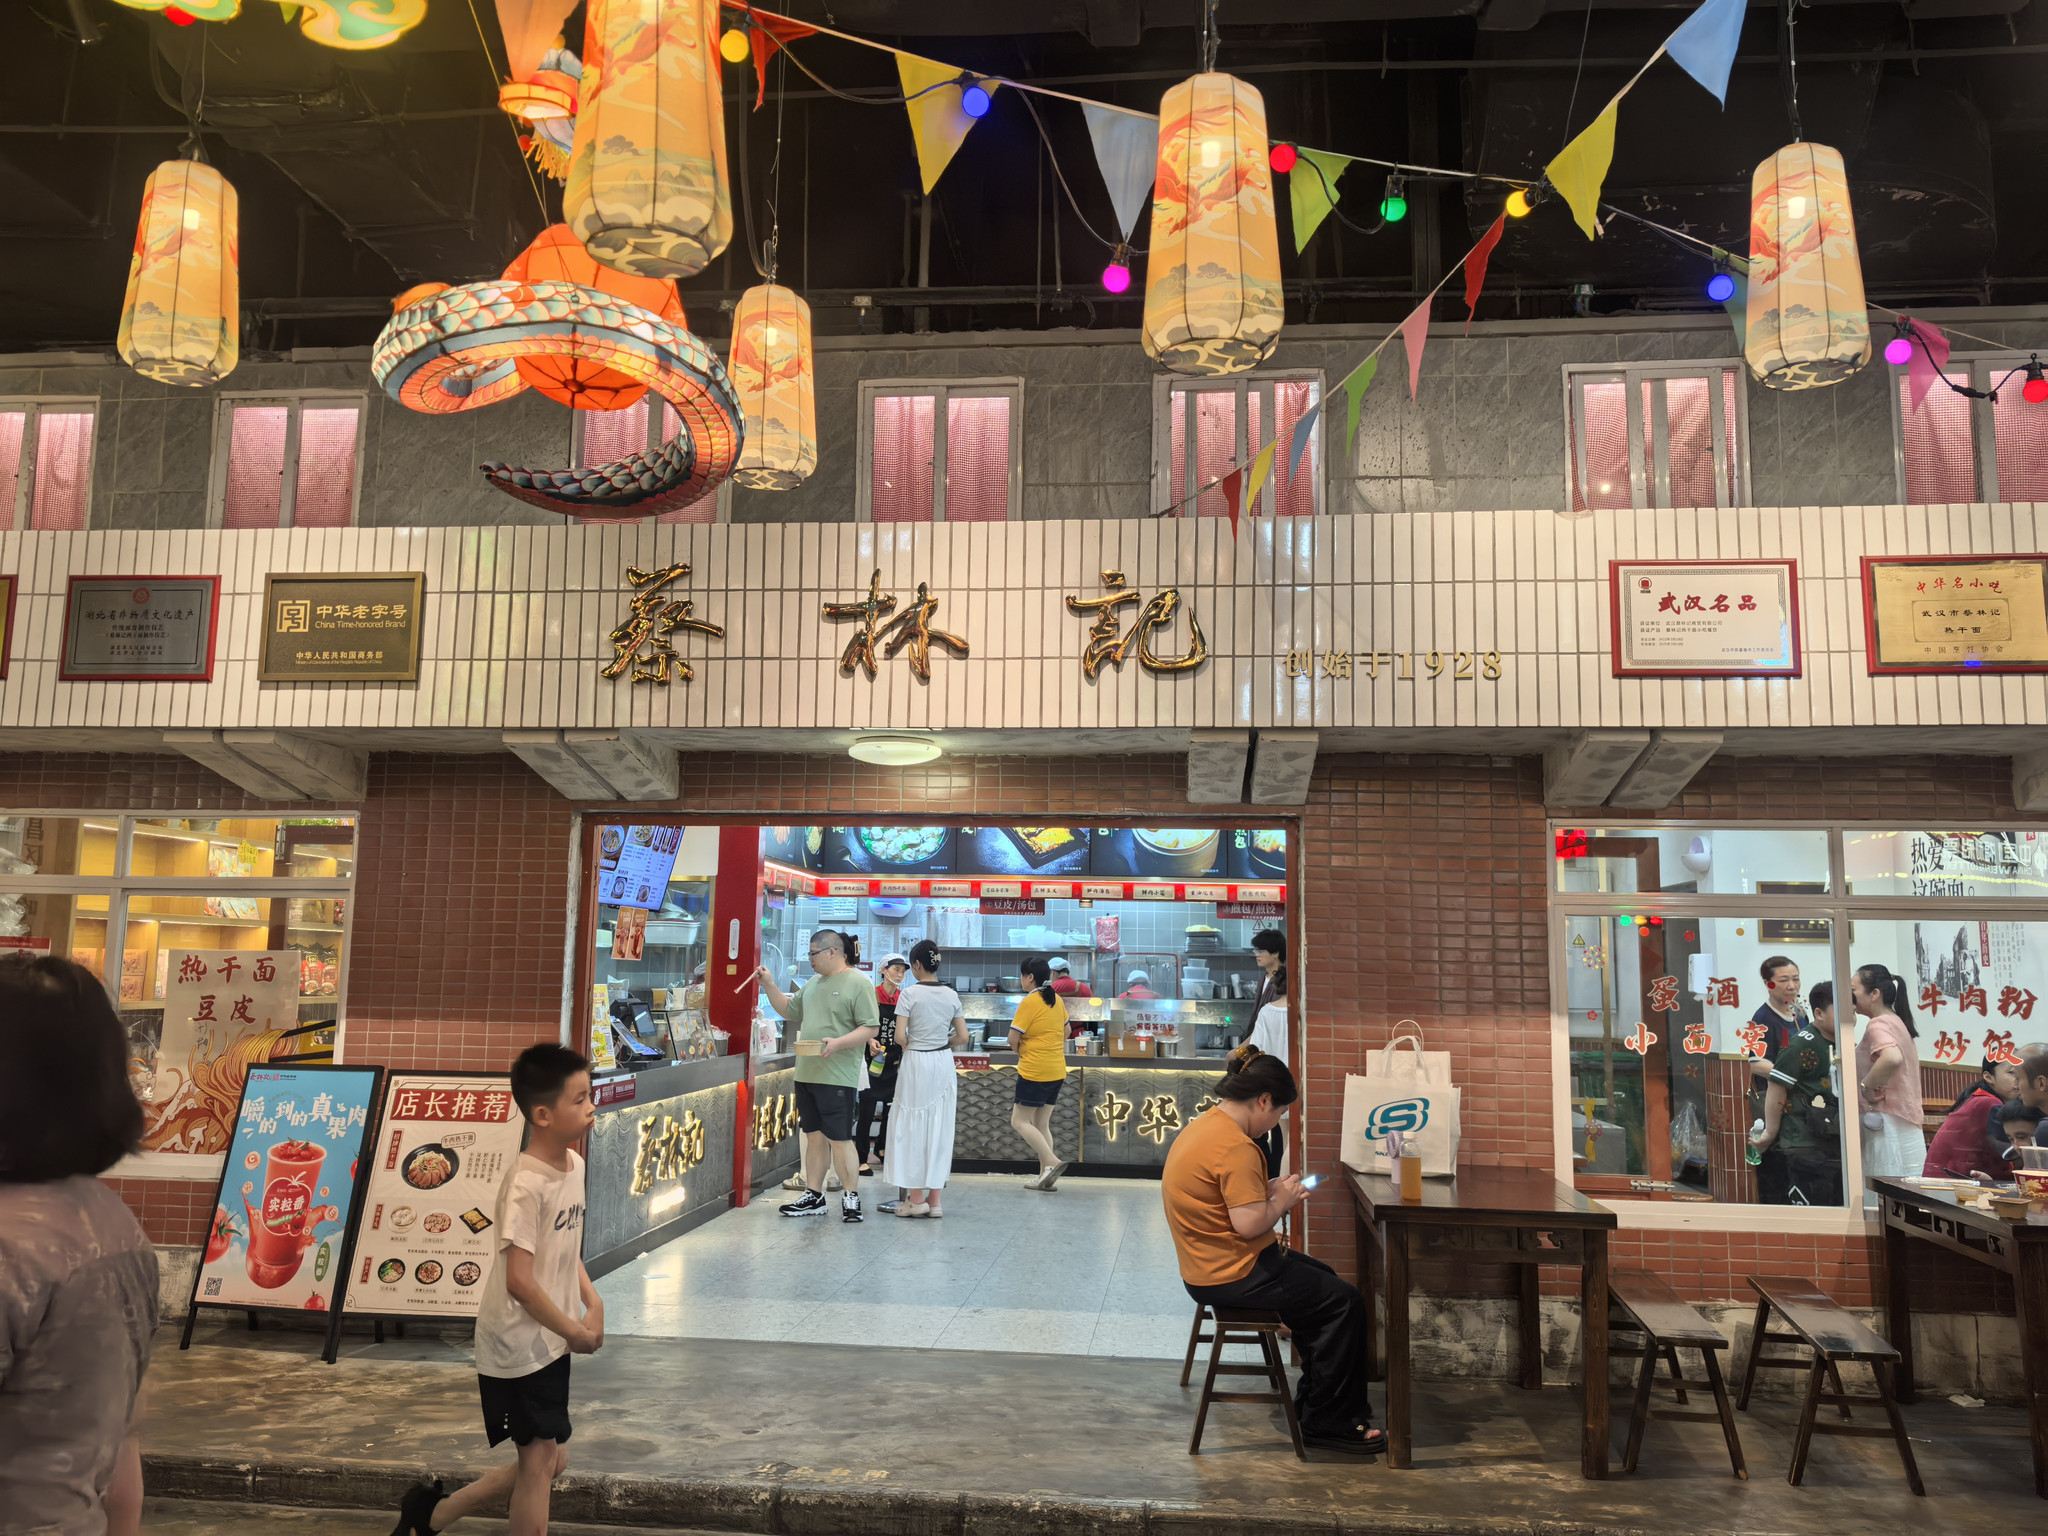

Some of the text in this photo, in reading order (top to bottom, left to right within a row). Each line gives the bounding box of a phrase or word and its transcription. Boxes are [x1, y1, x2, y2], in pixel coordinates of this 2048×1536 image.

[1916, 576, 2003, 594] 中华名小吃
[315, 604, 408, 620] 中华老字号
[1658, 591, 1758, 615] 武汉名品
[1921, 609, 2001, 618] 武汉市蔡林记
[314, 619, 407, 629] China Time-honored Brand
[1944, 626, 1982, 634] 热干面
[295, 651, 384, 660] 中华人民共和国商务部
[1283, 650, 1502, 681] 创始于1928
[1911, 837, 1945, 875] 热爱
[178, 954, 276, 984] 热干面
[1647, 976, 1739, 1011] 蛋酒
[1917, 984, 2038, 1020] 牛肉粉
[193, 995, 256, 1024] 豆皮
[1625, 1020, 1768, 1058] 小面窝
[1934, 1029, 2024, 1066] 炒饭
[392, 1090, 508, 1120] 店长推荐
